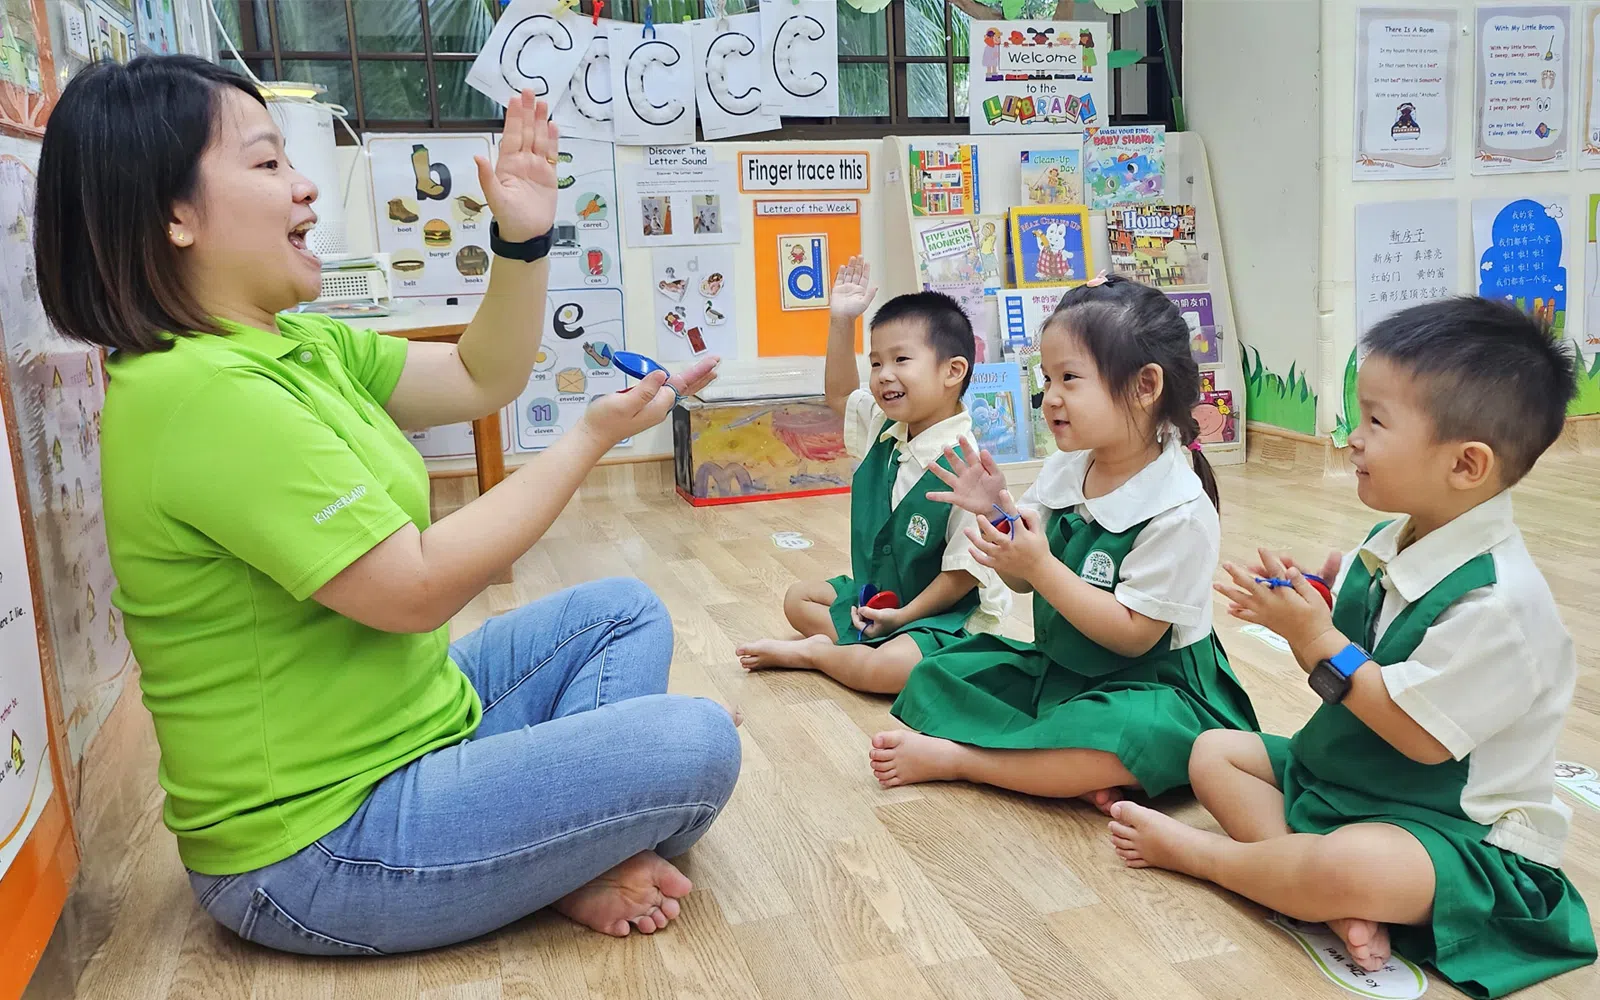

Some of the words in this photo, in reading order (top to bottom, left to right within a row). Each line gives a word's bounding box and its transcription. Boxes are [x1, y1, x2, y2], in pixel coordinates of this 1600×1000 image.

[1008, 51, 1077, 63] Welcome
[1026, 84, 1036, 93] to
[1040, 83, 1057, 93] the
[988, 97, 1092, 119] LIBRARY
[1093, 135, 1120, 146] BABY
[648, 146, 686, 155] Discover
[689, 146, 706, 155] The
[649, 157, 678, 165] Letter
[681, 157, 708, 165] Sound
[411, 144, 452, 200] b
[748, 159, 793, 186] Finger
[797, 159, 835, 181] trace
[839, 158, 863, 181] this
[763, 204, 793, 214] Letter
[796, 204, 806, 213] of
[809, 204, 824, 213] the
[826, 203, 851, 213] Week
[1123, 210, 1179, 230] Homes
[925, 231, 945, 243] FIVE
[928, 235, 972, 251] MONKEYS
[1390, 228, 1425, 243] 新房子
[1373, 251, 1403, 264] 新房子
[787, 238, 824, 300] d
[553, 303, 585, 339] e
[532, 404, 552, 421] 11
[312, 485, 366, 525] KINDERLAND
